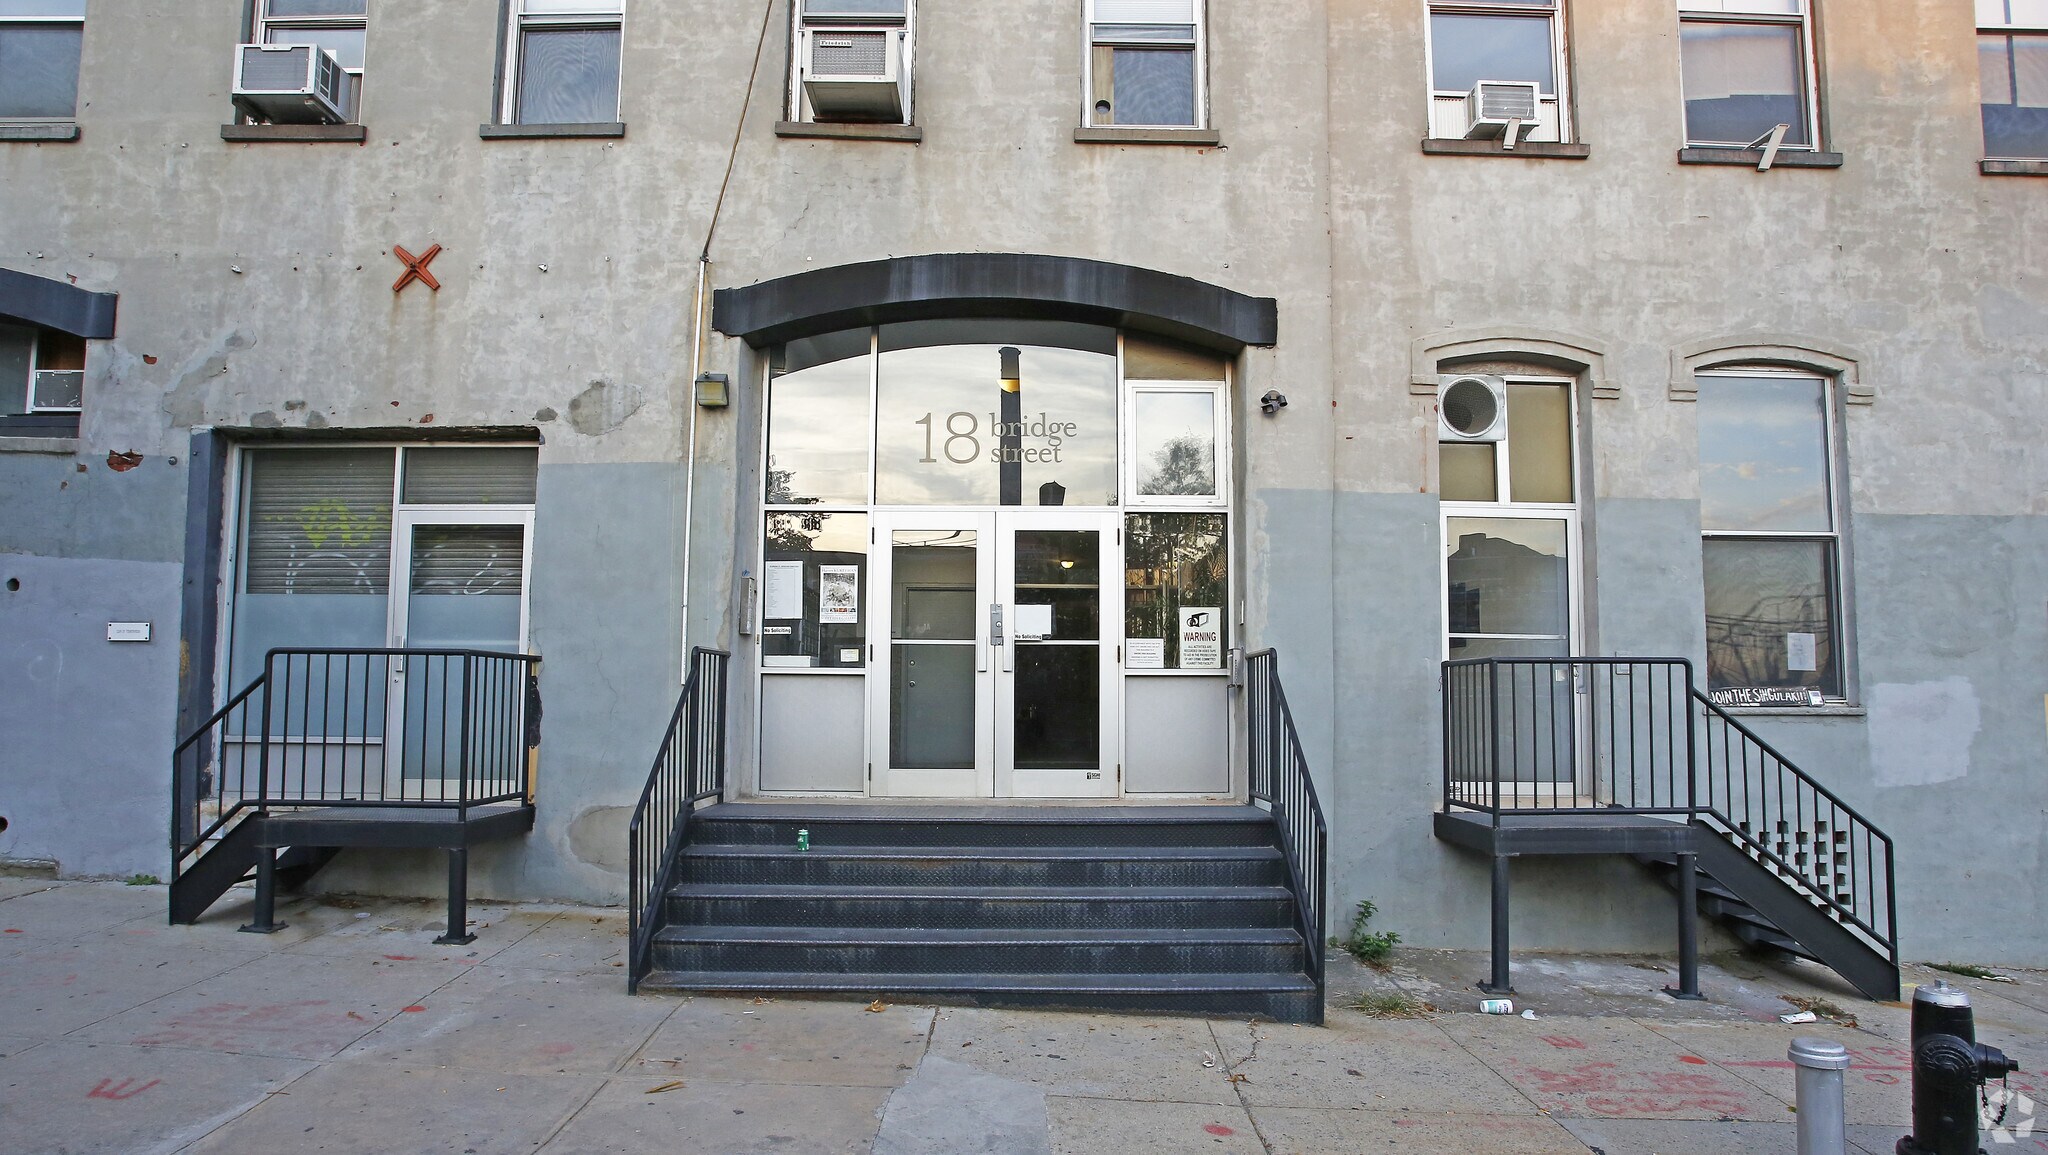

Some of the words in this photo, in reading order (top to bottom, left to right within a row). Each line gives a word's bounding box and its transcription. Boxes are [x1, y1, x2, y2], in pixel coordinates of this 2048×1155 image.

[915, 411, 980, 464] 18
[989, 412, 1077, 447] bridge
[990, 444, 1063, 463] street
[1183, 632, 1217, 641] WARNING
[1710, 690, 1733, 704] JOIN
[1732, 688, 1752, 702] THE
